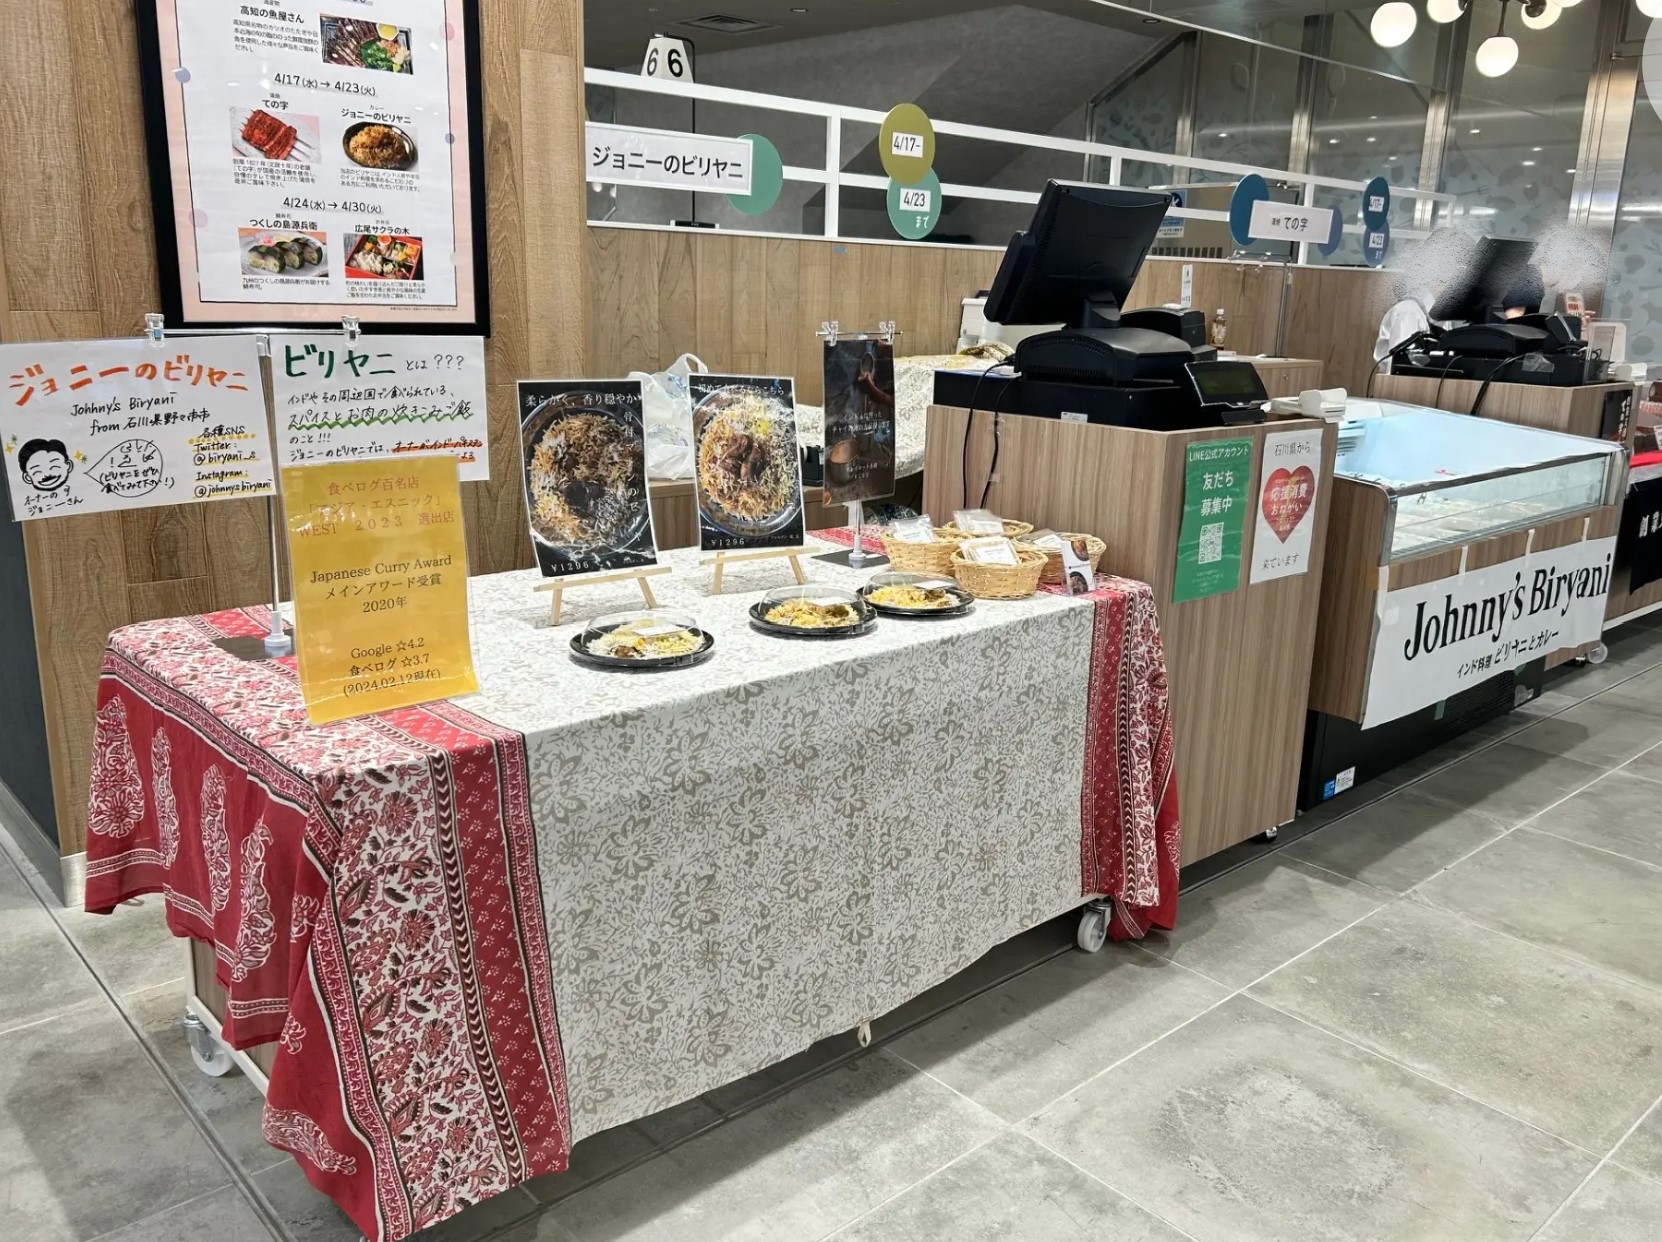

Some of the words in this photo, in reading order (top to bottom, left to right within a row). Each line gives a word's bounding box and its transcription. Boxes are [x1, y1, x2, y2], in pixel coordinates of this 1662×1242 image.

[240, 5, 304, 24] 高知の魚屋さん
[646, 47, 659, 76] 6
[667, 49, 684, 77] 6
[274, 73, 318, 89] 4/17(水)
[334, 81, 376, 97] 4/23(火)
[262, 99, 289, 110] ての字
[341, 109, 411, 124] ジョニーのビリヤニ
[894, 136, 920, 152] 4/17-
[592, 145, 743, 178] ジョニーのビリヤニ
[283, 197, 325, 211] 4/24(水)
[342, 201, 381, 214] 4/30(火)
[904, 192, 925, 207] 4/23
[250, 219, 317, 231] つくしの島源兵衛
[355, 225, 410, 235] 広尾サクラの木
[1284, 217, 1308, 231] ての字
[285, 344, 395, 378] ビリヤニ
[9, 354, 248, 407] ジョニーのビリヤニ
[129, 391, 177, 410] Biryani
[90, 419, 120, 436] from
[1190, 446, 1249, 462] LINE公式アカウント
[1275, 441, 1311, 456] 石川県から
[328, 475, 419, 496] 食べログ百名店
[1203, 471, 1234, 491] 友だち
[28, 496, 84, 516] ジョニーさん
[1201, 495, 1233, 517] 募集中
[300, 522, 338, 538] WEST
[418, 511, 454, 525] 選出店
[310, 566, 371, 584] Japanese
[375, 560, 410, 575] Curry
[414, 555, 452, 569] Award
[1262, 553, 1300, 570] 来ています
[325, 573, 442, 600] メインアワード受賞
[363, 596, 408, 613] 2020年
[1404, 571, 1526, 661] Johnny's
[1527, 553, 1612, 617] Biryani
[351, 644, 392, 659] Google
[1457, 654, 1492, 678] インド料理
[1494, 629, 1559, 664] ビリヤニとカレー
[350, 657, 397, 676] 食べログ
